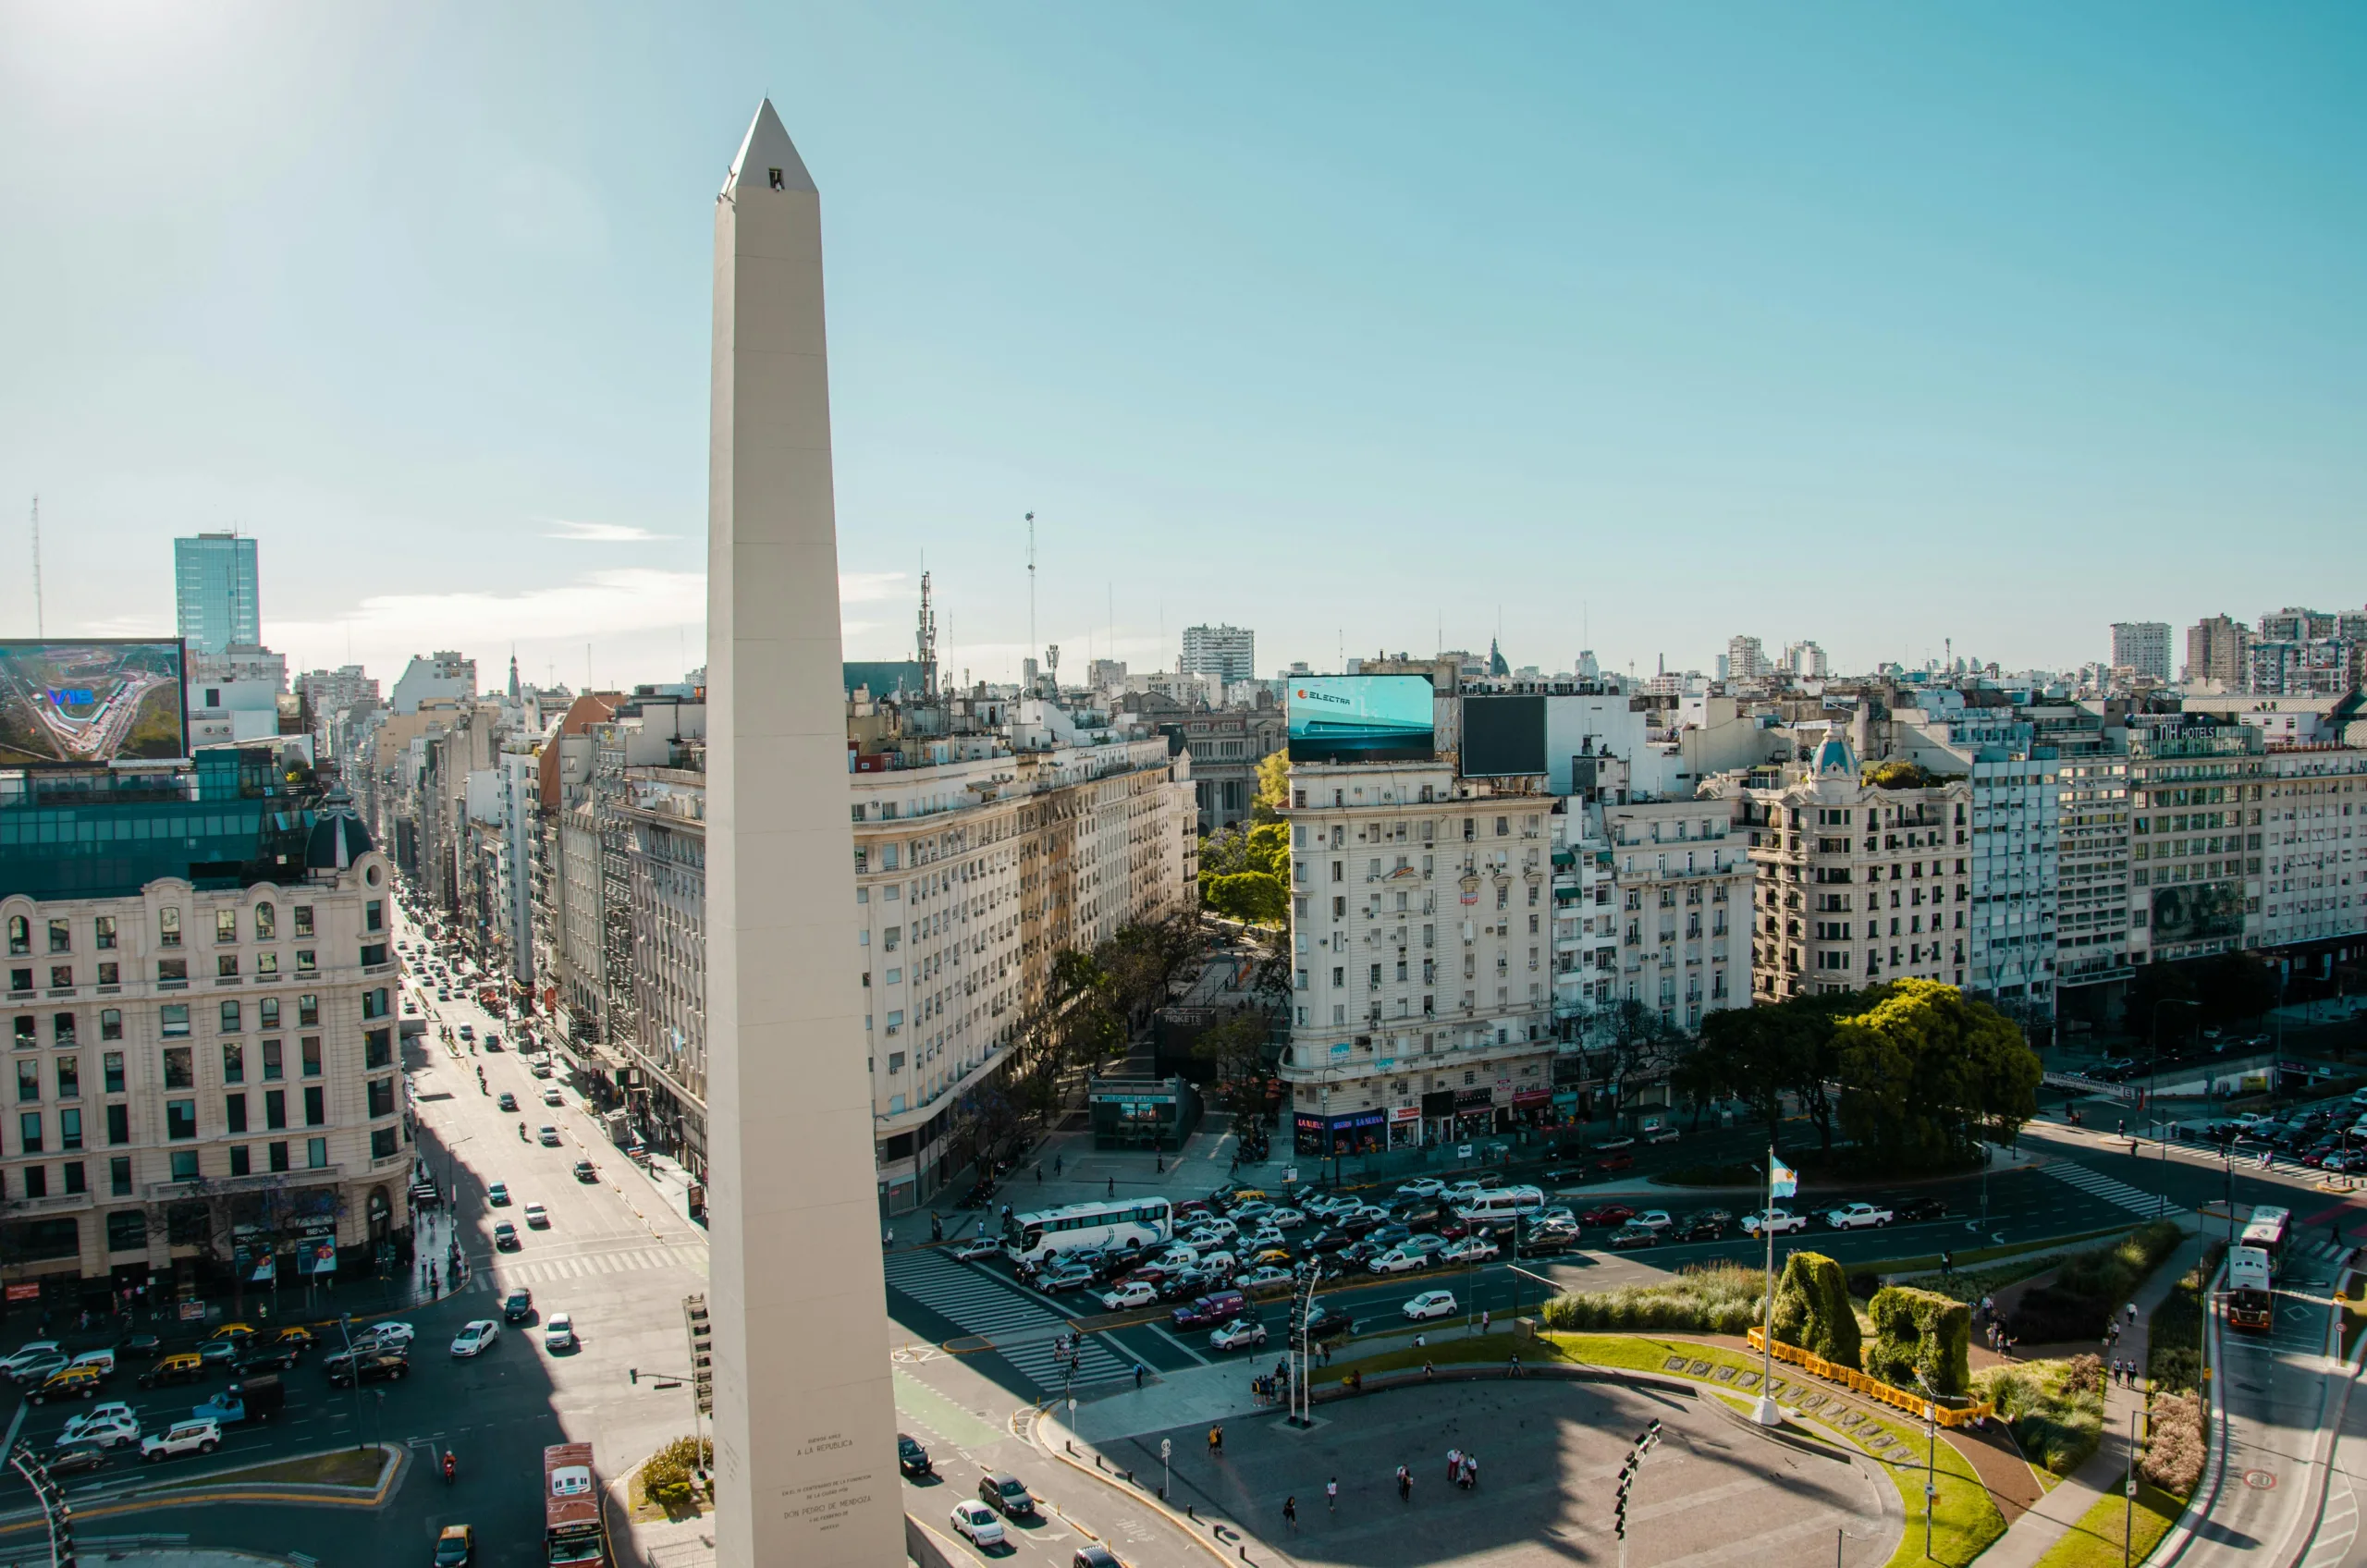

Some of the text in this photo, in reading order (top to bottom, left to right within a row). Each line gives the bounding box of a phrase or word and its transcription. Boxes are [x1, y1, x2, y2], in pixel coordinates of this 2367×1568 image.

[1309, 691, 1351, 705] ELECTRA
[2181, 727, 2214, 740] HOTELS
[2046, 1072, 2120, 1091] ESTACIONAMIENTO
[1298, 1119, 1306, 1127] LA
[1355, 1118, 1365, 1127] LA
[372, 1209, 387, 1222] BBVA
[306, 1227, 330, 1236] BBVA
[804, 1446, 813, 1454] LA
[816, 1439, 852, 1452] REPUBLICA
[803, 1482, 831, 1492] CENTENARIO
[847, 1475, 871, 1483] FUNDACION
[784, 1495, 871, 1518] DON PEDRO DE MENDOZA
